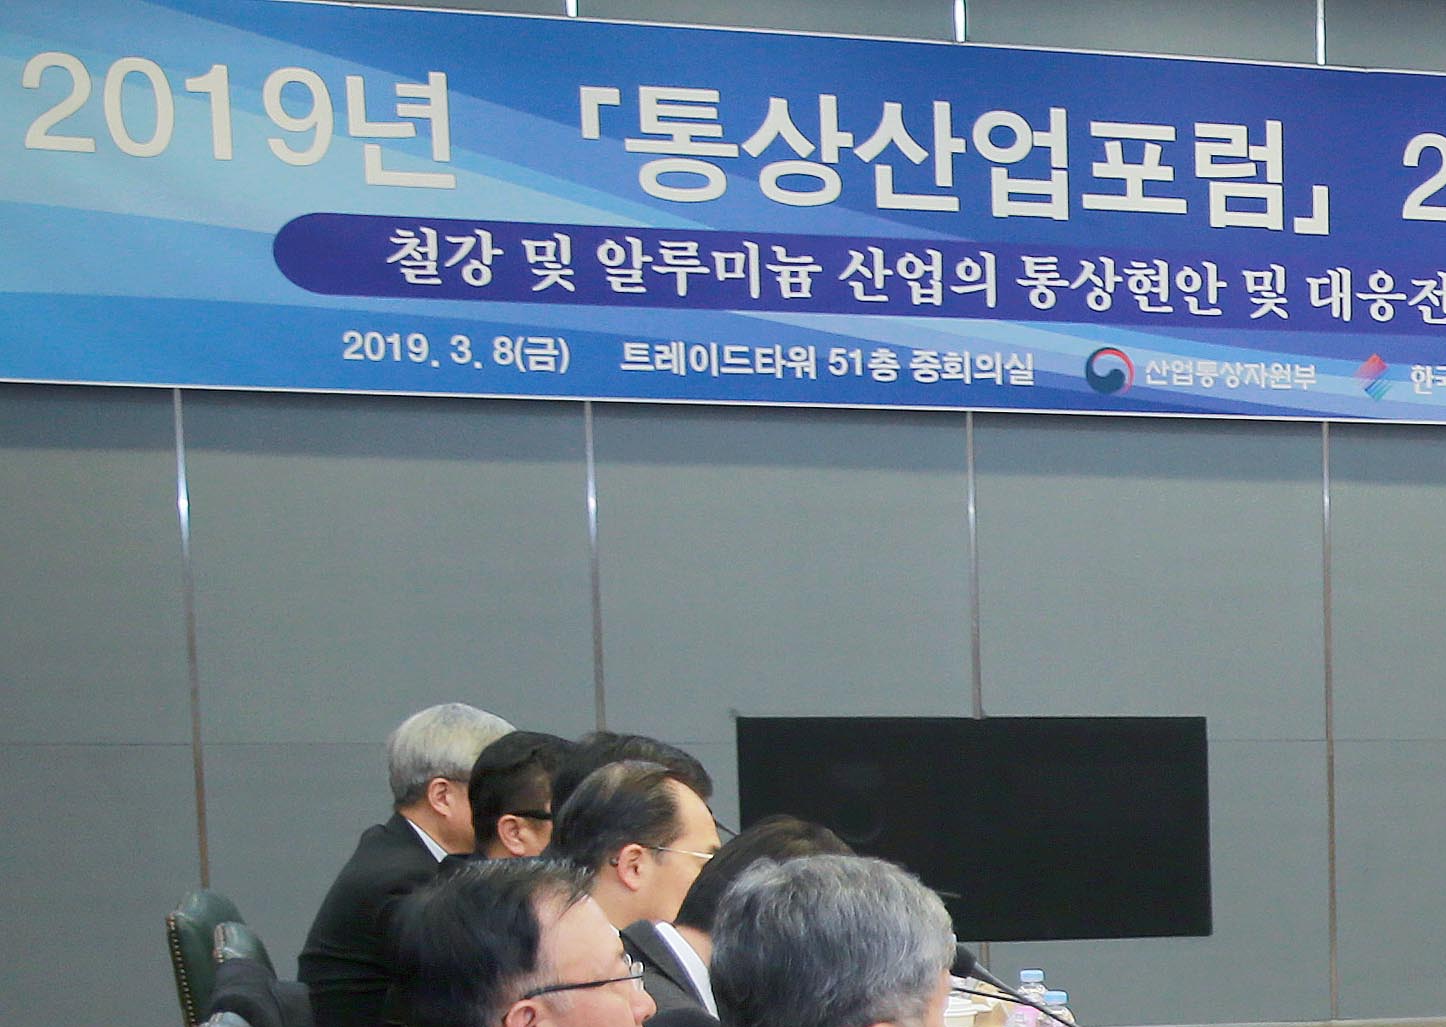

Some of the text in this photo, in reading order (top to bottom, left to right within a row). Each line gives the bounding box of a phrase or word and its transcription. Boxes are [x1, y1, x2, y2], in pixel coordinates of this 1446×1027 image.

[21, 52, 457, 190] 2019년
[579, 84, 1331, 237] 「통상산업포럼」
[386, 227, 504, 289] 철강
[521, 232, 576, 293] 및
[596, 234, 823, 300] 알루미늄
[838, 246, 999, 310] 산업의
[1015, 255, 1228, 317] 통상현안
[1244, 262, 1291, 321] 및
[342, 331, 571, 376] 2019. 3. 8(금)
[620, 343, 1036, 388] 트레이드타워 51층 중회의실
[1144, 356, 1318, 392] 산업통상자원부
